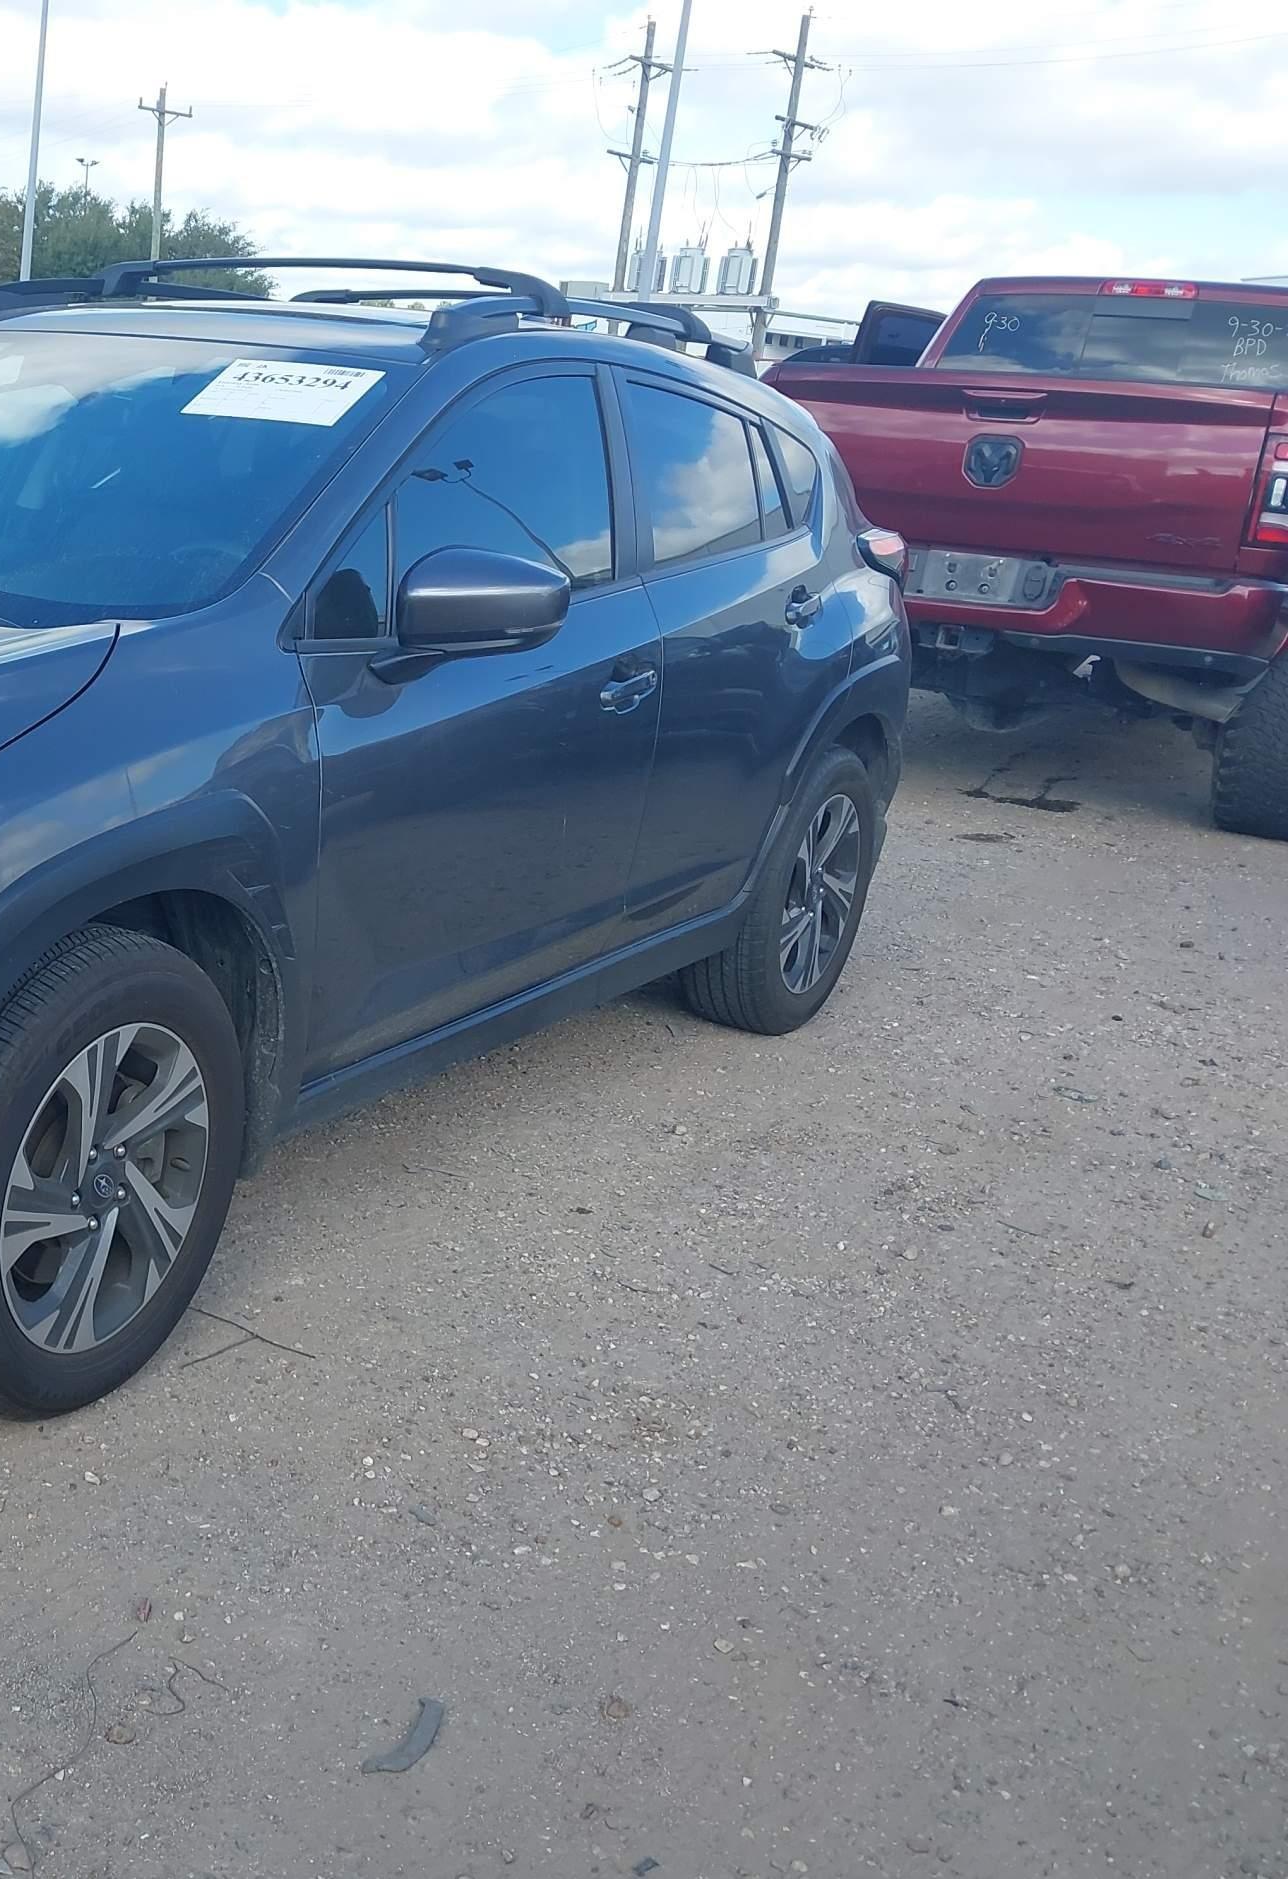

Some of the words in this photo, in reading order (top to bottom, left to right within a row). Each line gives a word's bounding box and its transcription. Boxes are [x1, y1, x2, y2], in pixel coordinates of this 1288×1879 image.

[1228, 315, 1288, 337] 9-30-
[1233, 337, 1267, 356] BPD
[232, 371, 352, 390] 43653294
